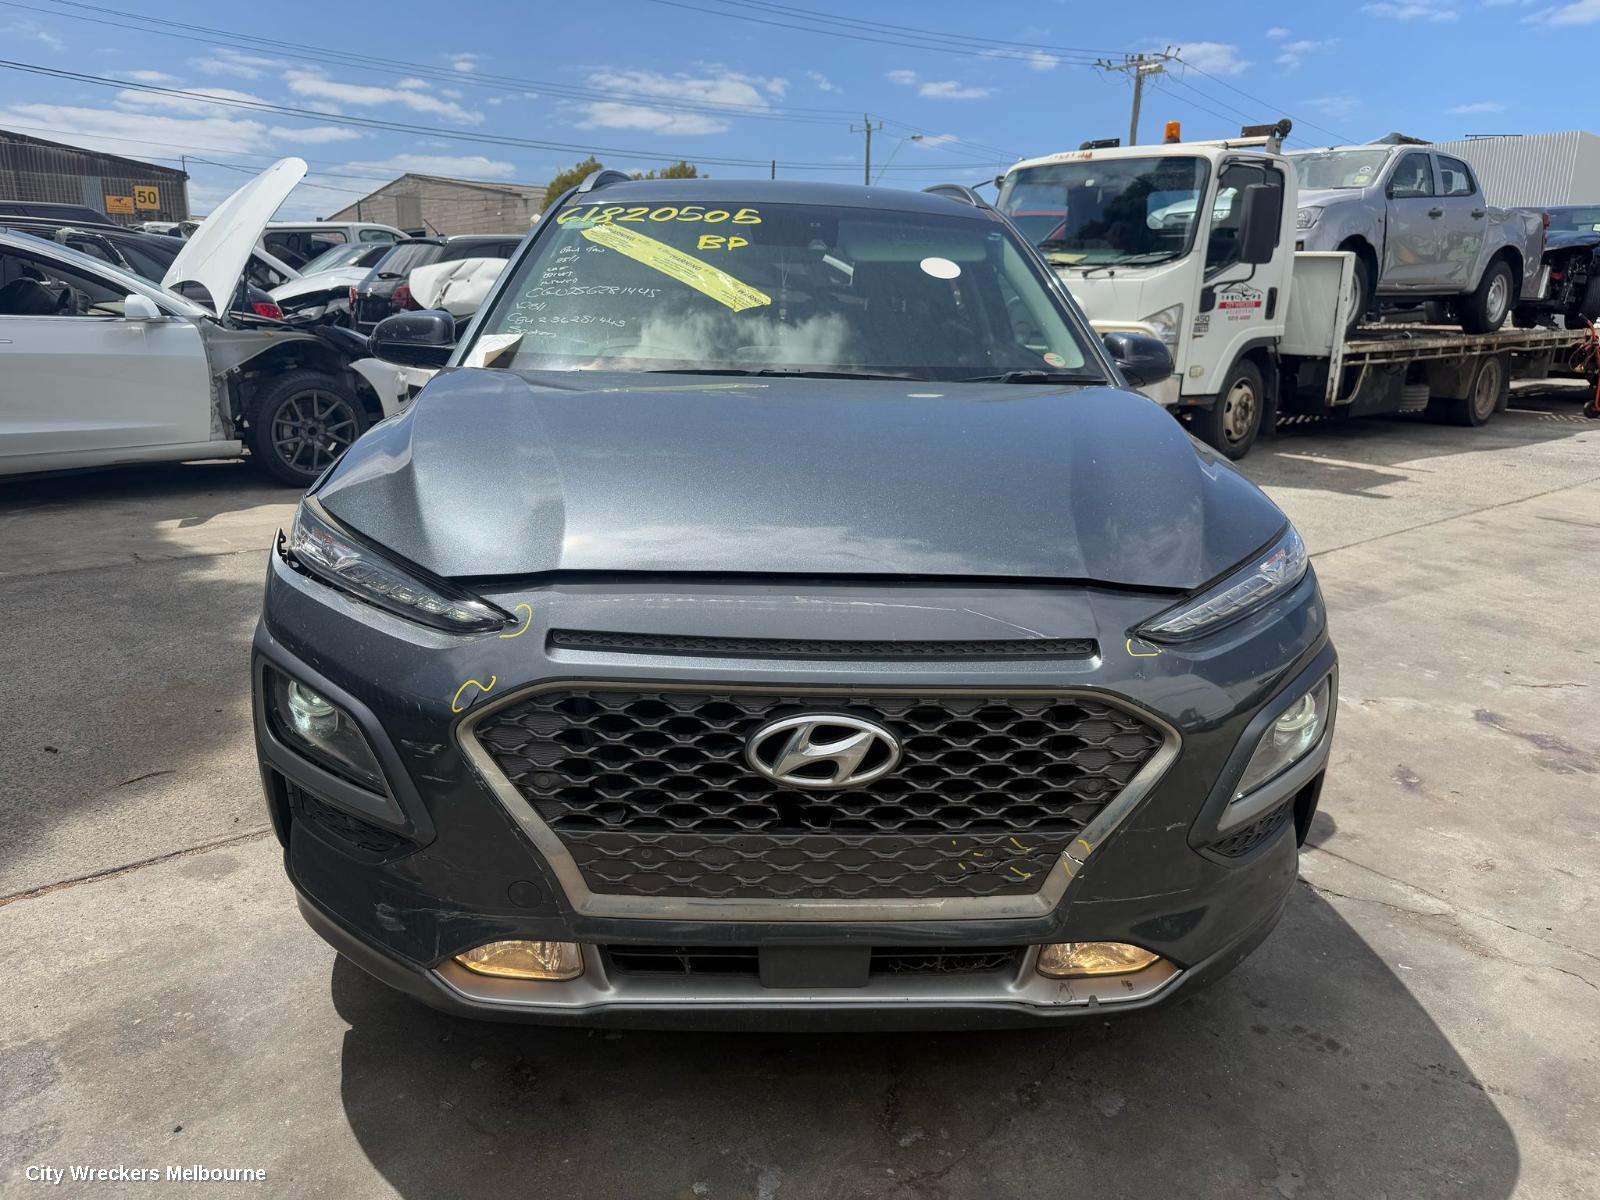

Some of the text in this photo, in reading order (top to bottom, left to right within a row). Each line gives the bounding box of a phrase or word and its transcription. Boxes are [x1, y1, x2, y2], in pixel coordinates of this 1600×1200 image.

[137, 191, 157, 205] 50
[557, 206, 762, 225] 61820505
[696, 234, 749, 251] BP
[670, 254, 703, 271] WARNING
